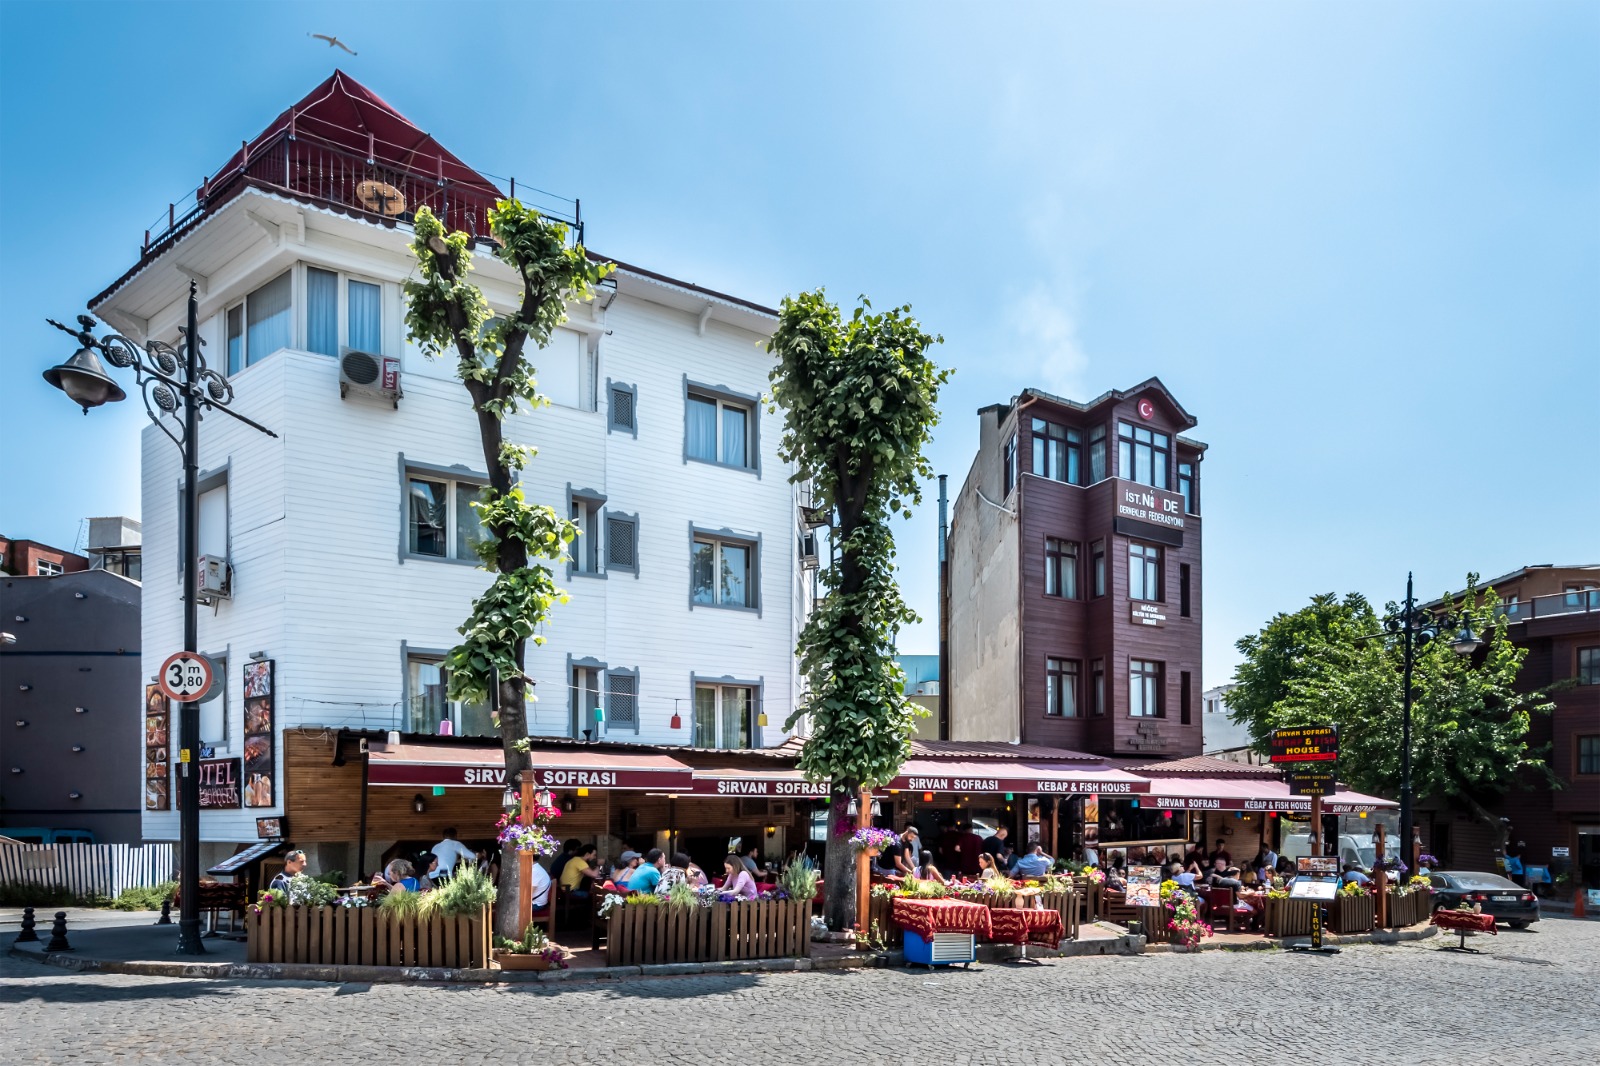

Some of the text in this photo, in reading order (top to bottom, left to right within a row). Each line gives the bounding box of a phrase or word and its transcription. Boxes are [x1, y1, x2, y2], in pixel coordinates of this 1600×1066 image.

[1120, 505, 1184, 527] DERNEKLER FEDERASYONU
[199, 763, 236, 785] TEL
[543, 770, 617, 785] SOFRASI
[775, 782, 831, 794] SOFRASI
[953, 779, 999, 790] SOFRASI
[1037, 781, 1068, 792] KEBAP
[1070, 782, 1078, 792] &
[1101, 783, 1131, 793] HOUSE
[1188, 799, 1220, 808] SOFRASI
[1244, 800, 1267, 809] KEBAP
[1268, 801, 1274, 809] &
[1290, 802, 1312, 810] HOUSE
